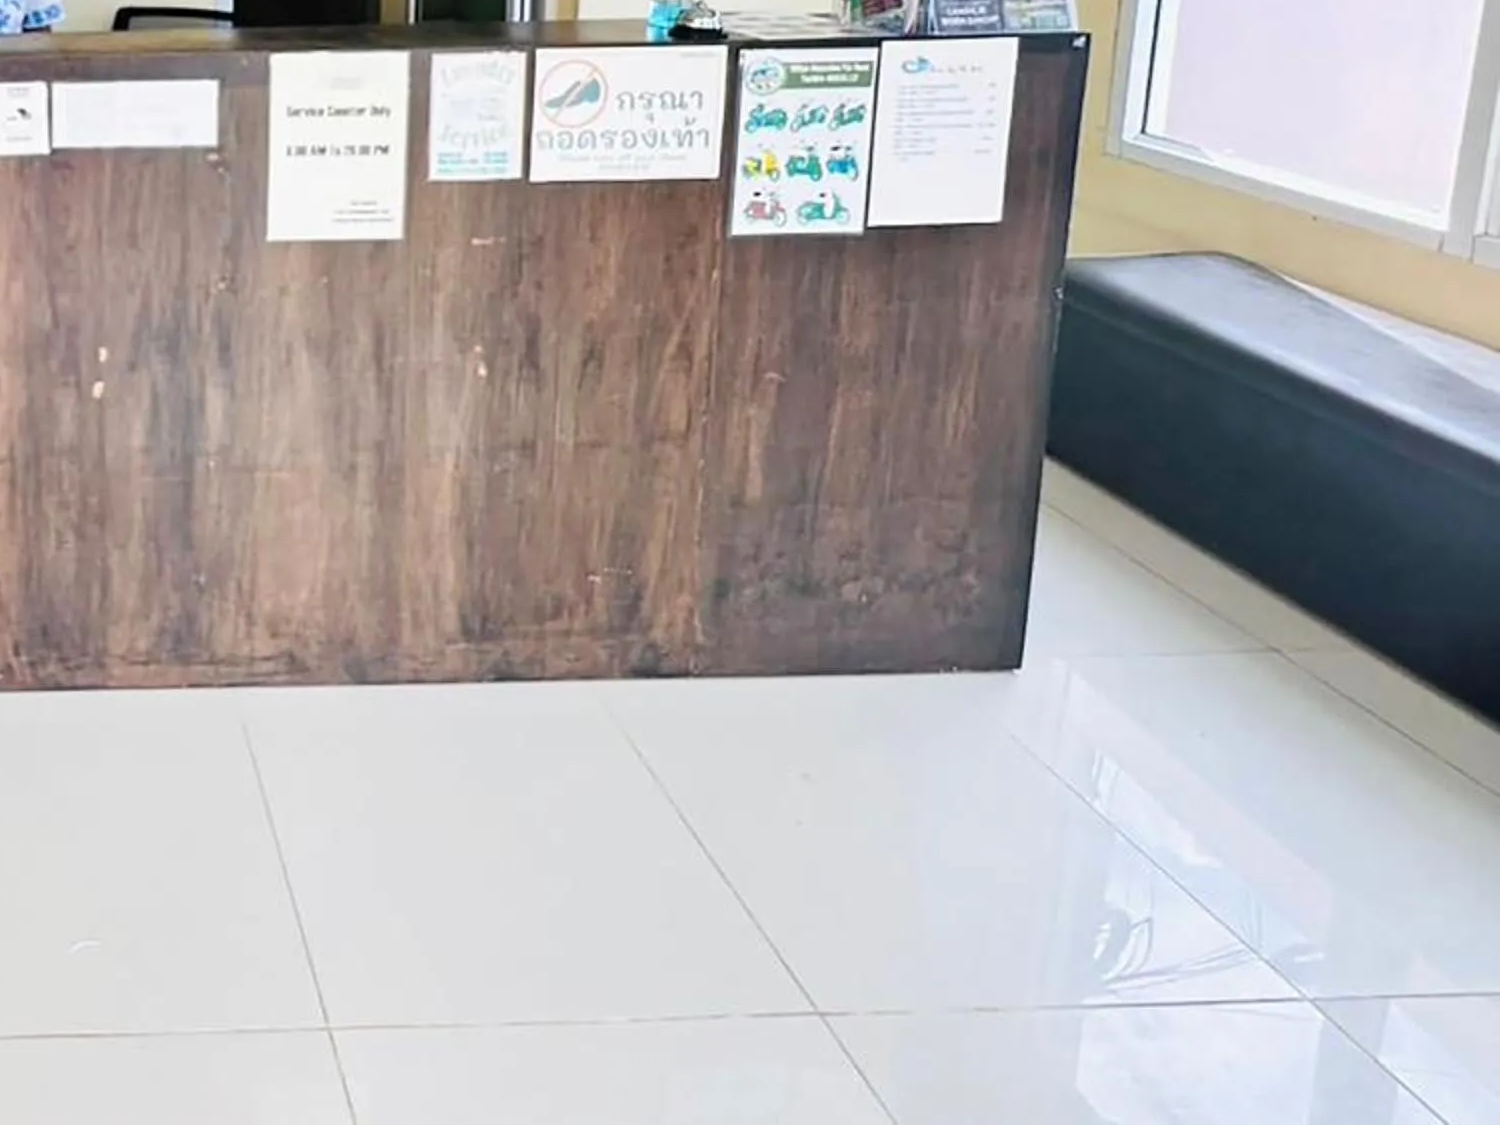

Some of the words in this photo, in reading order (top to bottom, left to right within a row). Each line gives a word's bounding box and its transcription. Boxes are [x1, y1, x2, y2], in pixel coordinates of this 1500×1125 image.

[616, 90, 703, 123] กรุณา
[535, 116, 710, 150] ถอดรองเท้า
